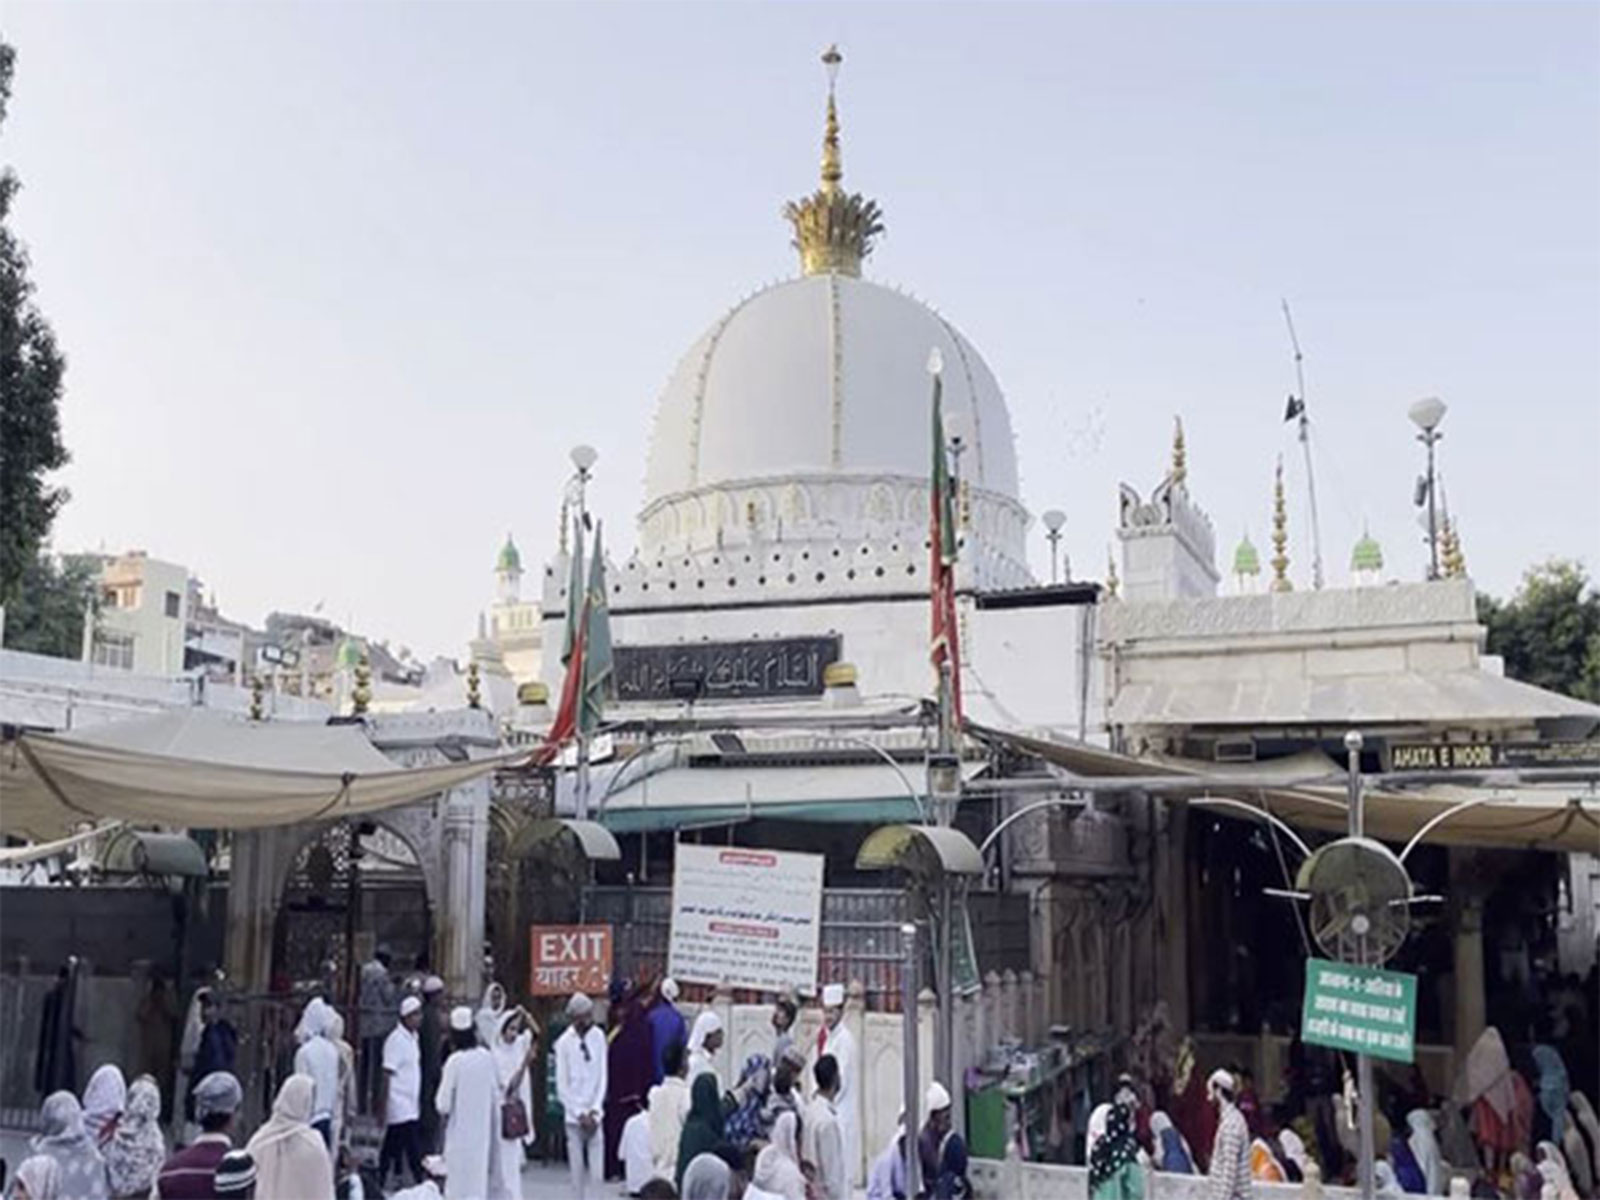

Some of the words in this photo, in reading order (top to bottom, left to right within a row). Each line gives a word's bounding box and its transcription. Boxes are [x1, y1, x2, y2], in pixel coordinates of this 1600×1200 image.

[1394, 747, 1437, 766] AHATA
[1440, 746, 1450, 767] E
[1453, 746, 1493, 767] NOOR
[541, 932, 605, 961] EXIT
